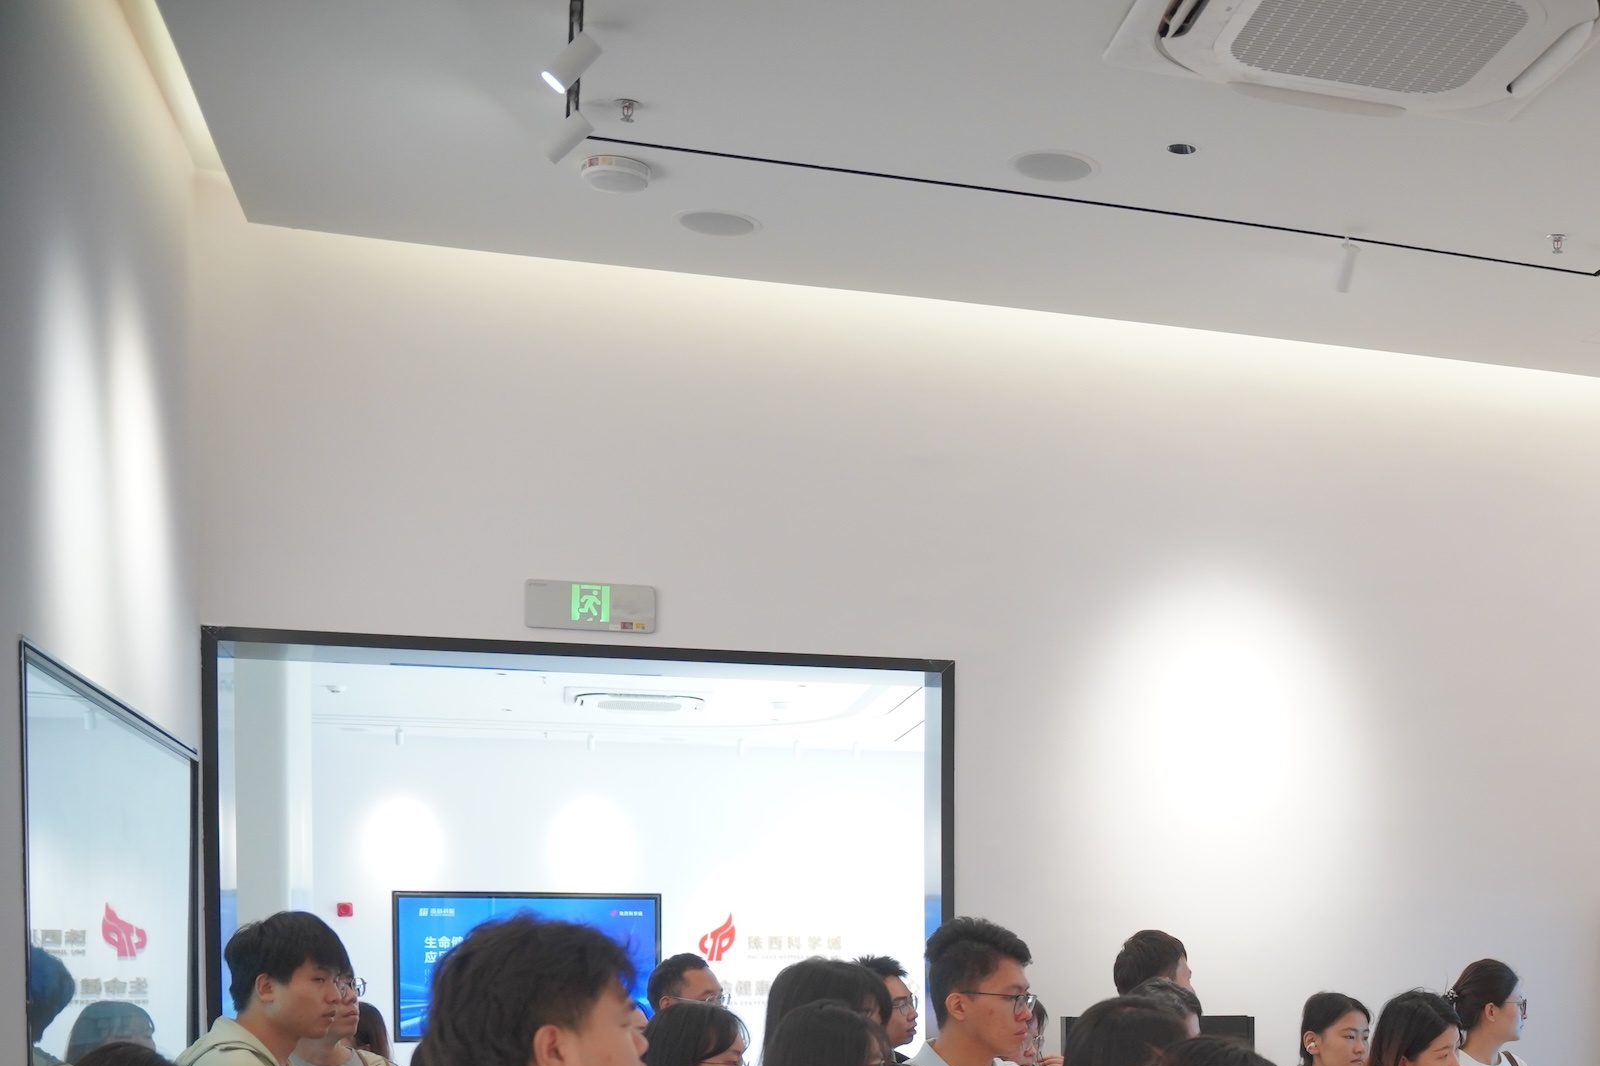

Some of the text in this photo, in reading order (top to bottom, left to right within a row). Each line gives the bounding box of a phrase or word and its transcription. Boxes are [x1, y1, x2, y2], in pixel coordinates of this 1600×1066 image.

[747, 936, 842, 950] 珠西科学城
[424, 951, 447, 963] 应
